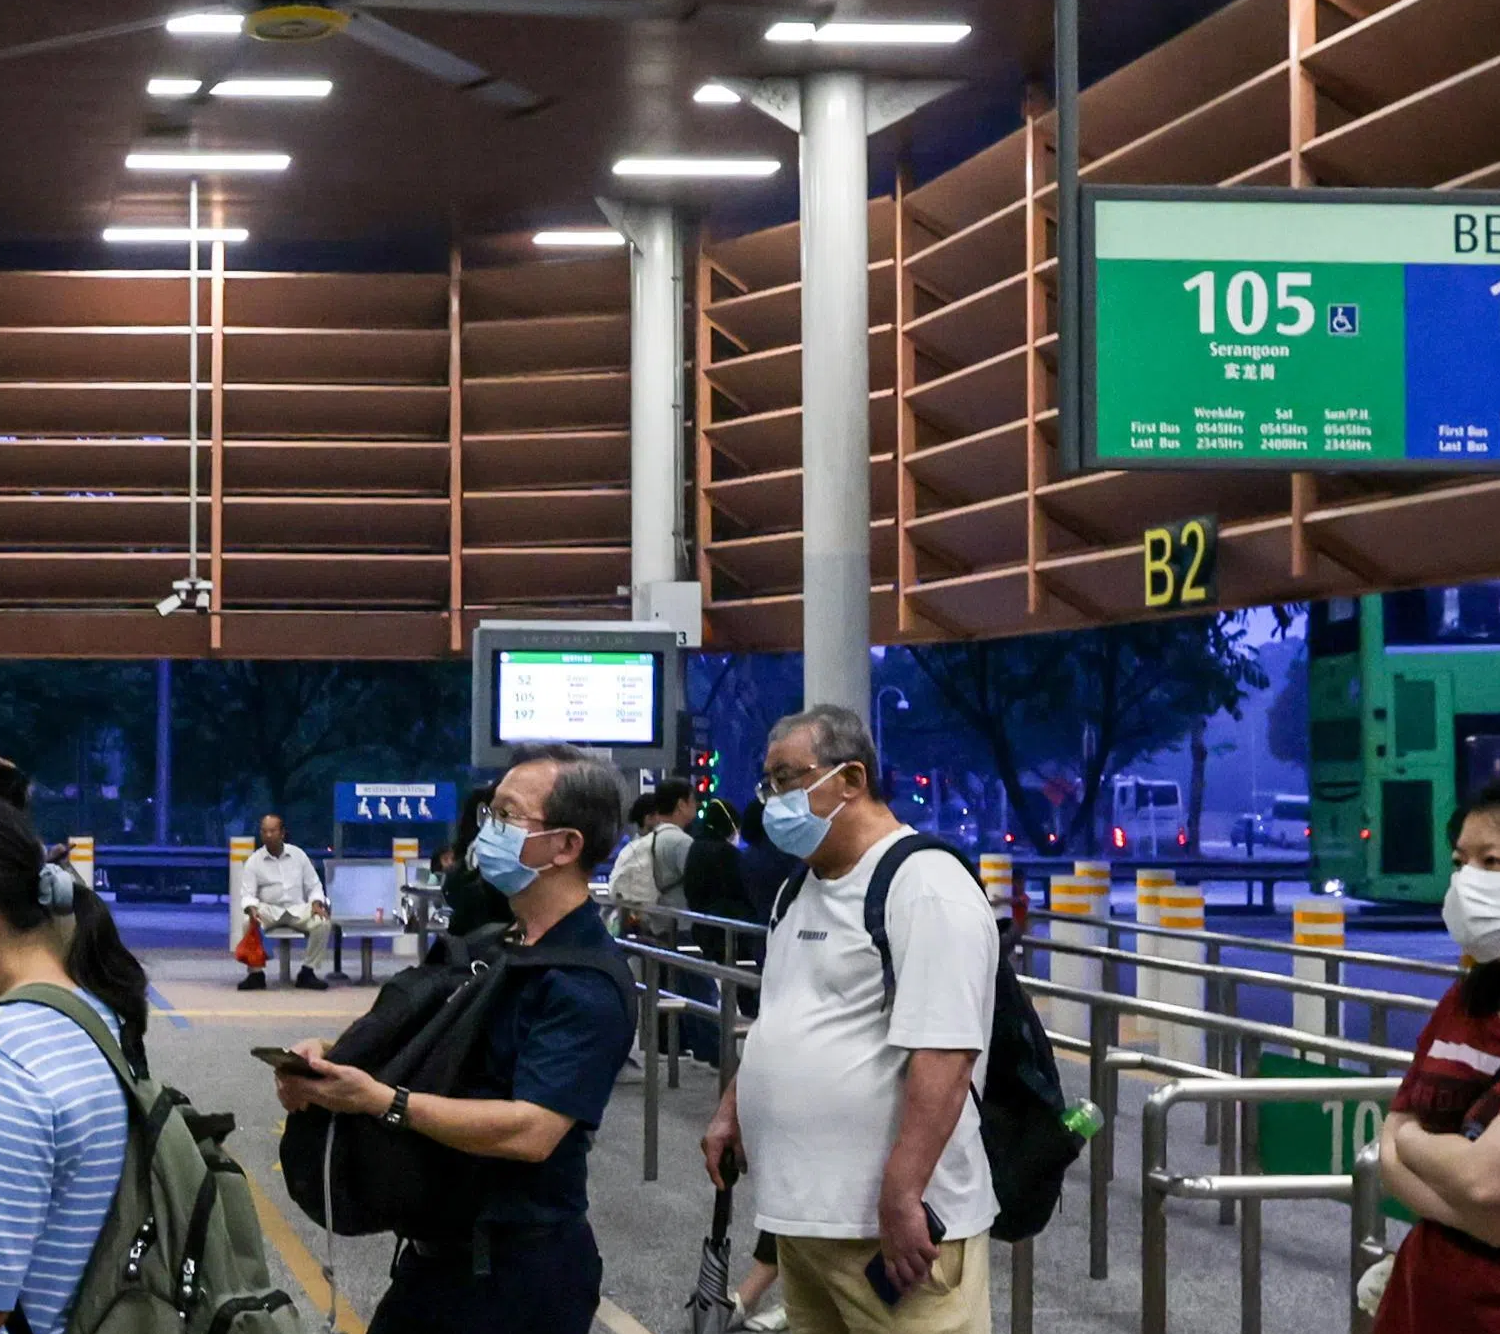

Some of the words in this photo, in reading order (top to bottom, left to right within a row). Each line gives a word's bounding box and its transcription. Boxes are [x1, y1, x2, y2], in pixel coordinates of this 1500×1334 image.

[1183, 270, 1316, 336] 105
[1209, 341, 1290, 361] Serangoon
[1194, 406, 1246, 420] Weekday
[1274, 408, 1294, 420] Sat
[1130, 421, 1156, 434] First
[1159, 421, 1181, 435] Bus
[1130, 436, 1154, 450] Last
[1159, 436, 1181, 450] Bus
[1144, 520, 1206, 607] B2
